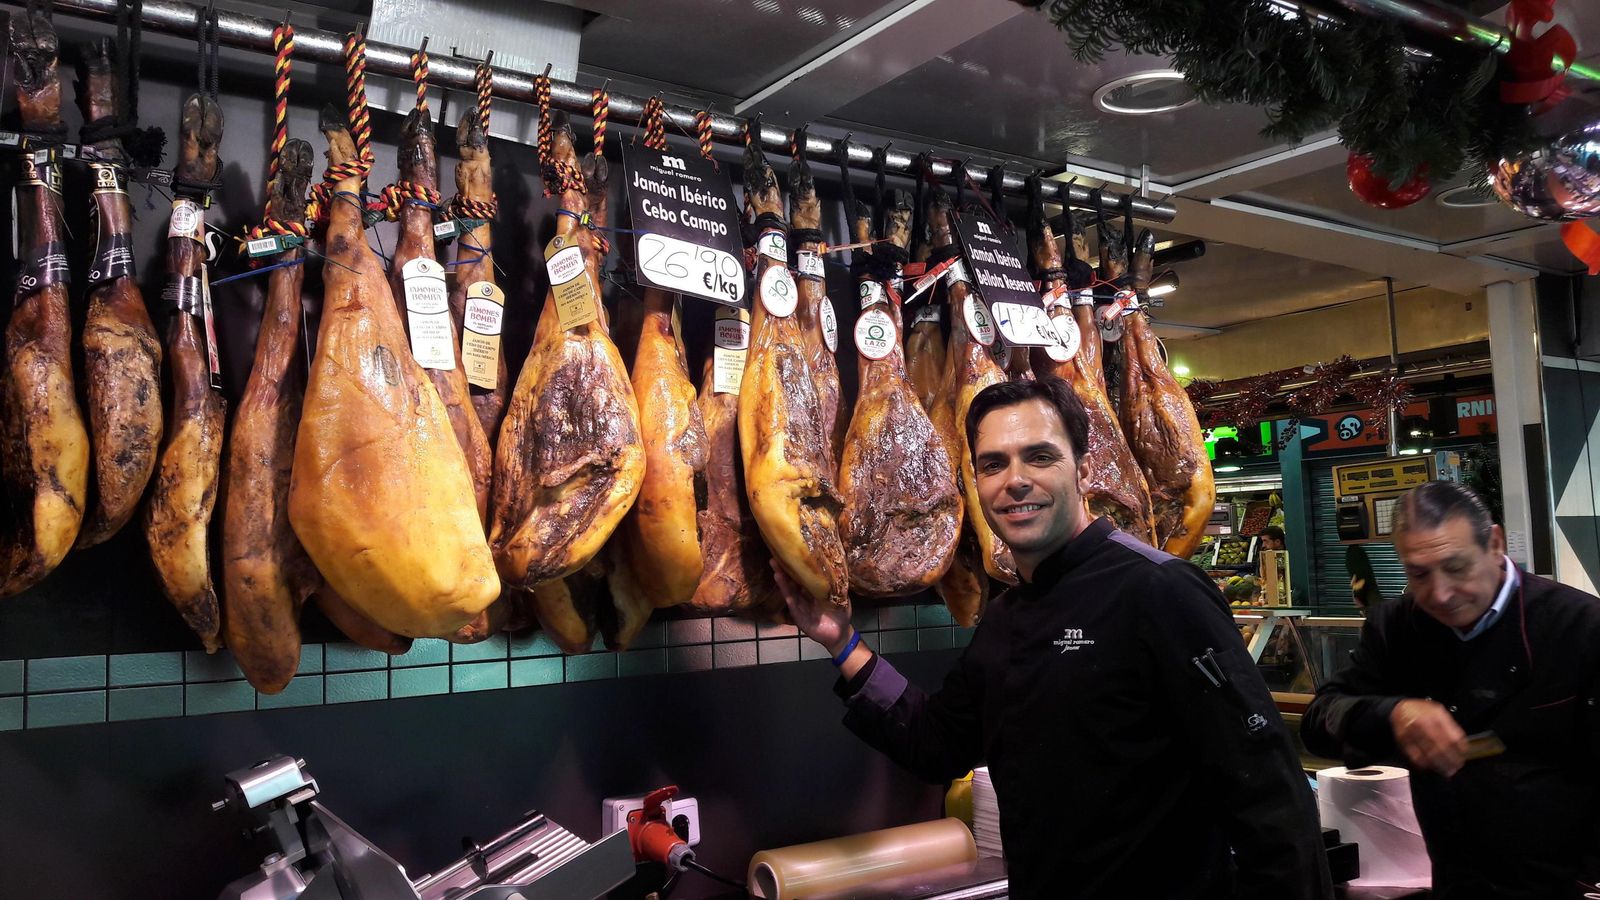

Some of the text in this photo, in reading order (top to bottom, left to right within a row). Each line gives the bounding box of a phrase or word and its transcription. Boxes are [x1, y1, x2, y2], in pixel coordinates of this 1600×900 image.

[650, 165, 702, 182] miguel romero
[633, 170, 727, 211] Jamón Ibérico
[642, 199, 728, 237] Cebo Campo
[968, 242, 1022, 270] Jamón Ibérico
[703, 271, 738, 300] €/kg
[975, 267, 1037, 293] Bellota Reserva
[864, 339, 886, 348] LAZO
[1456, 399, 1496, 418] RNI
